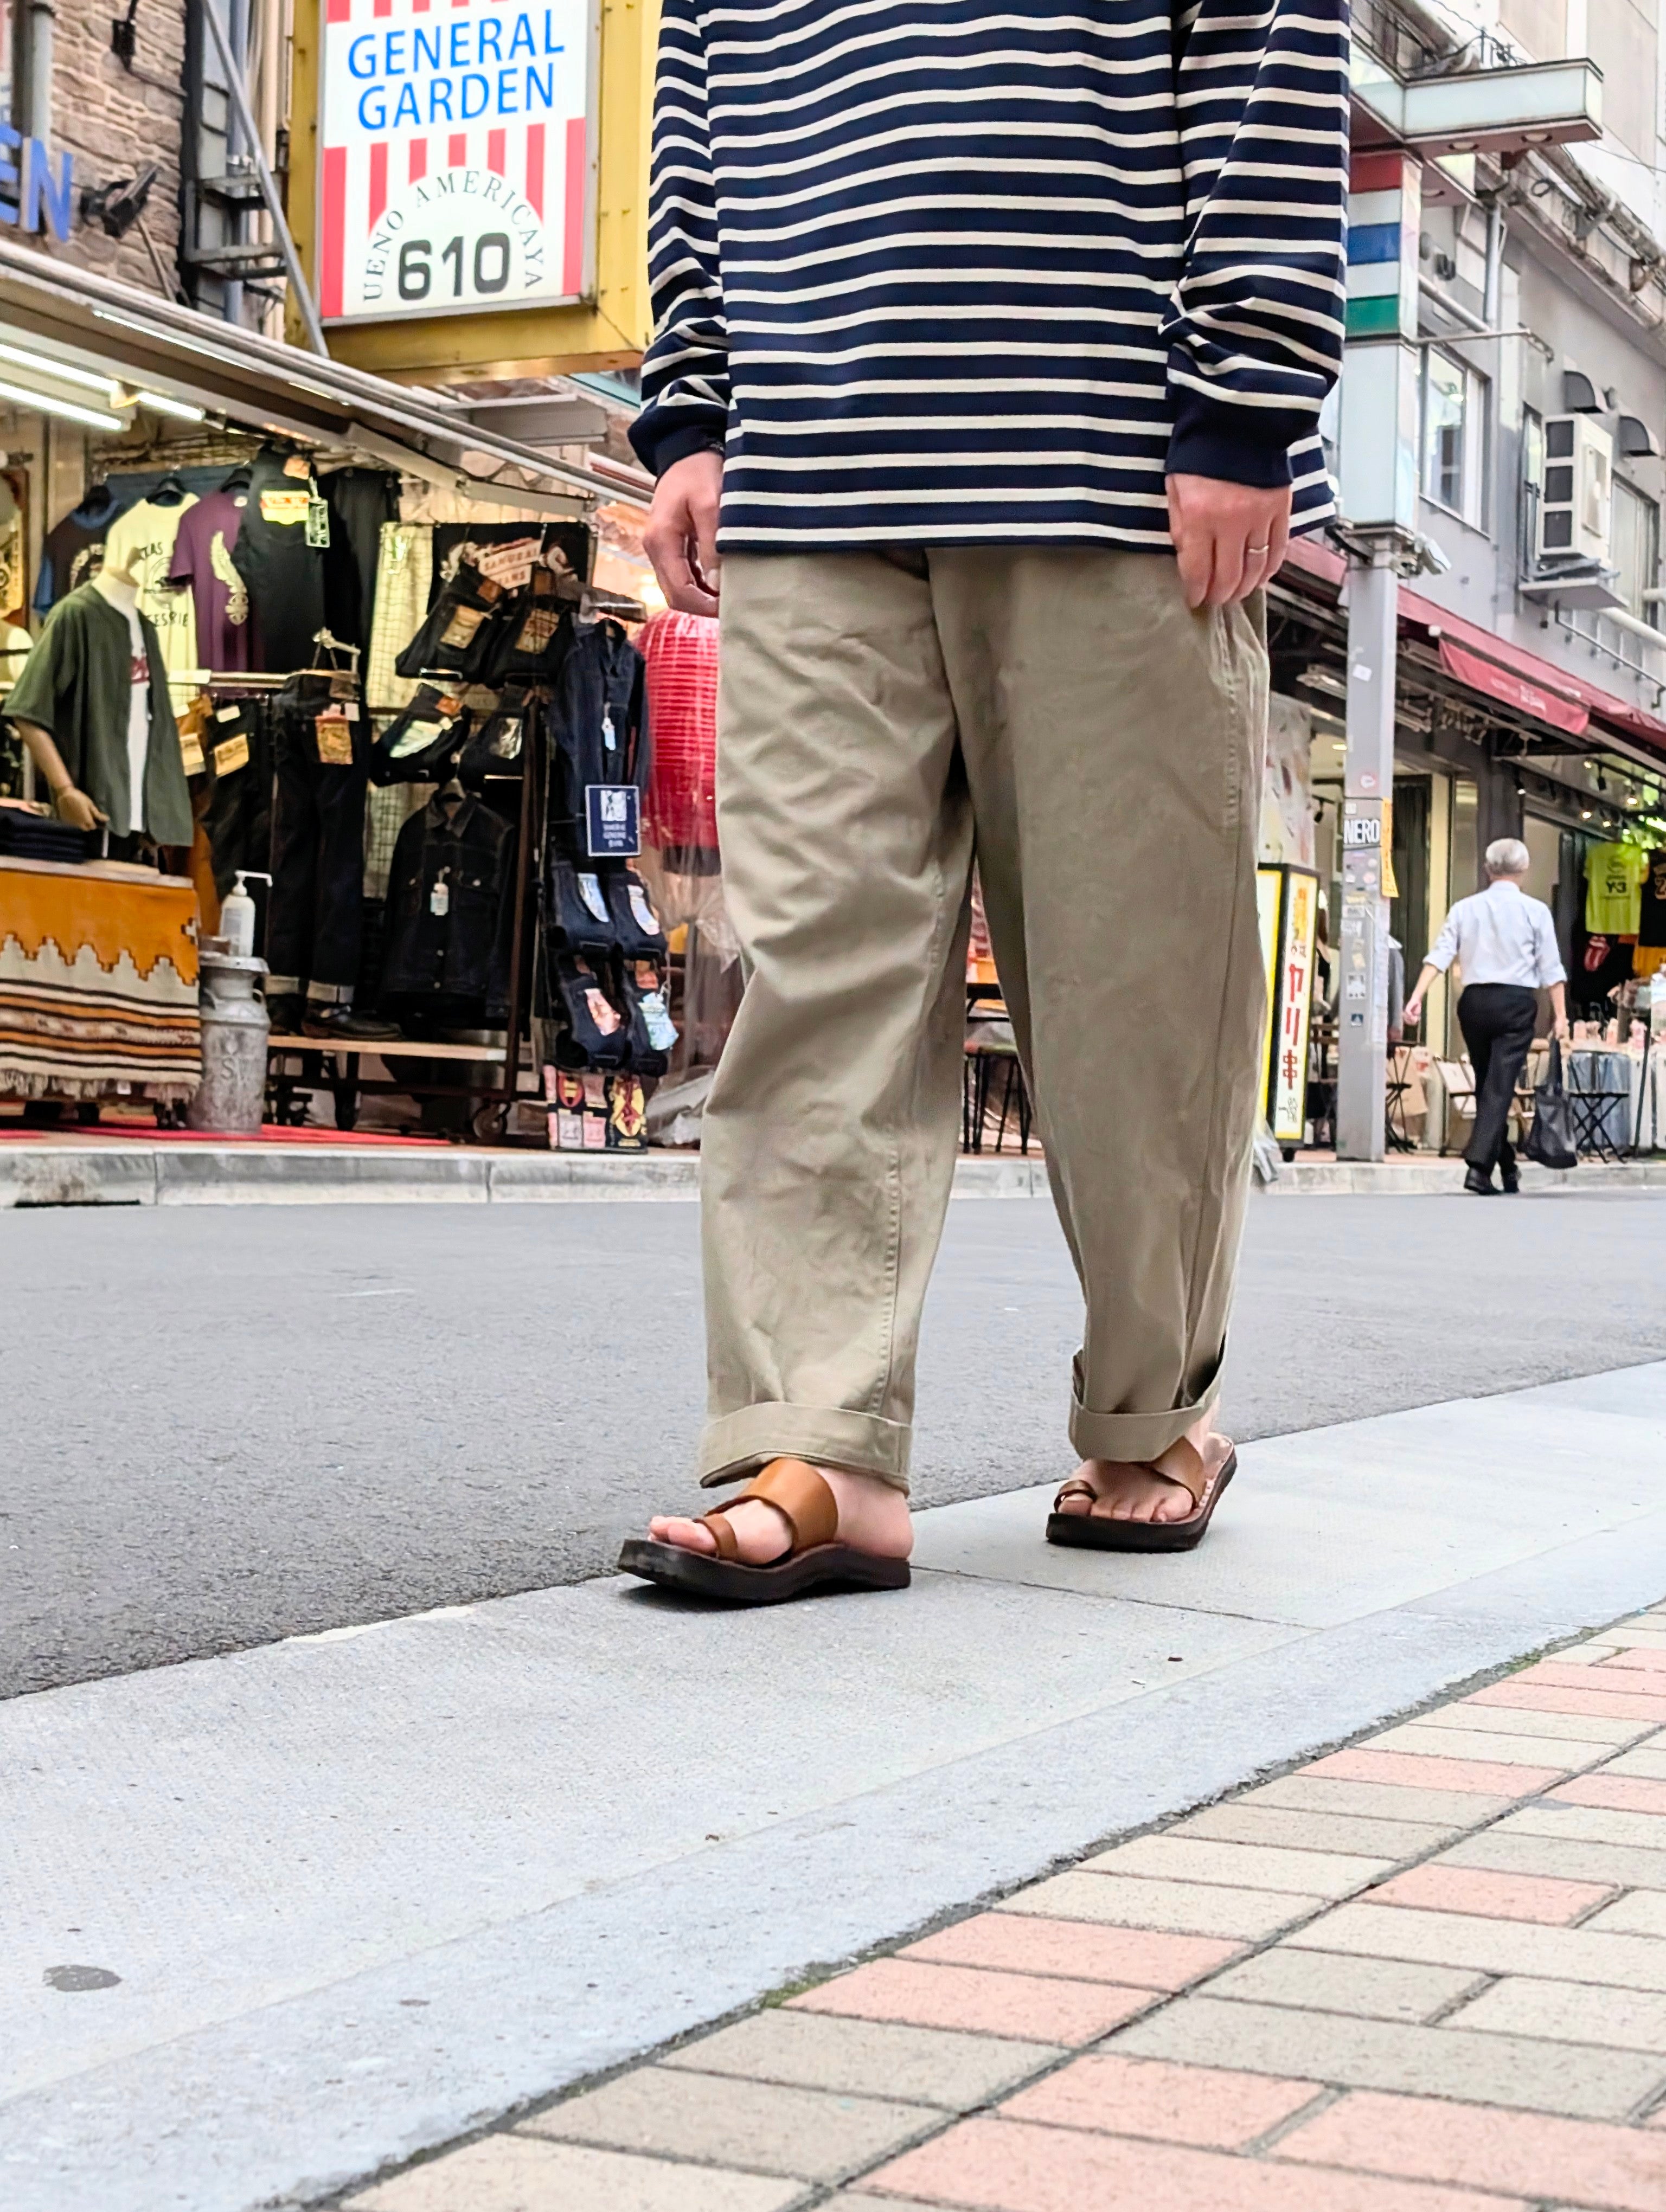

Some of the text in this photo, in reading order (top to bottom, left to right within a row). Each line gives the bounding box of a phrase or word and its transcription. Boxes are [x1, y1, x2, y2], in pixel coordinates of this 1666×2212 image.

[348, 9, 565, 80] GENERAL
[358, 62, 554, 131] GARDEN
[363, 170, 544, 301] UENO AMERICAYA
[398, 232, 510, 300] 610
[1343, 819, 1380, 844] NERO
